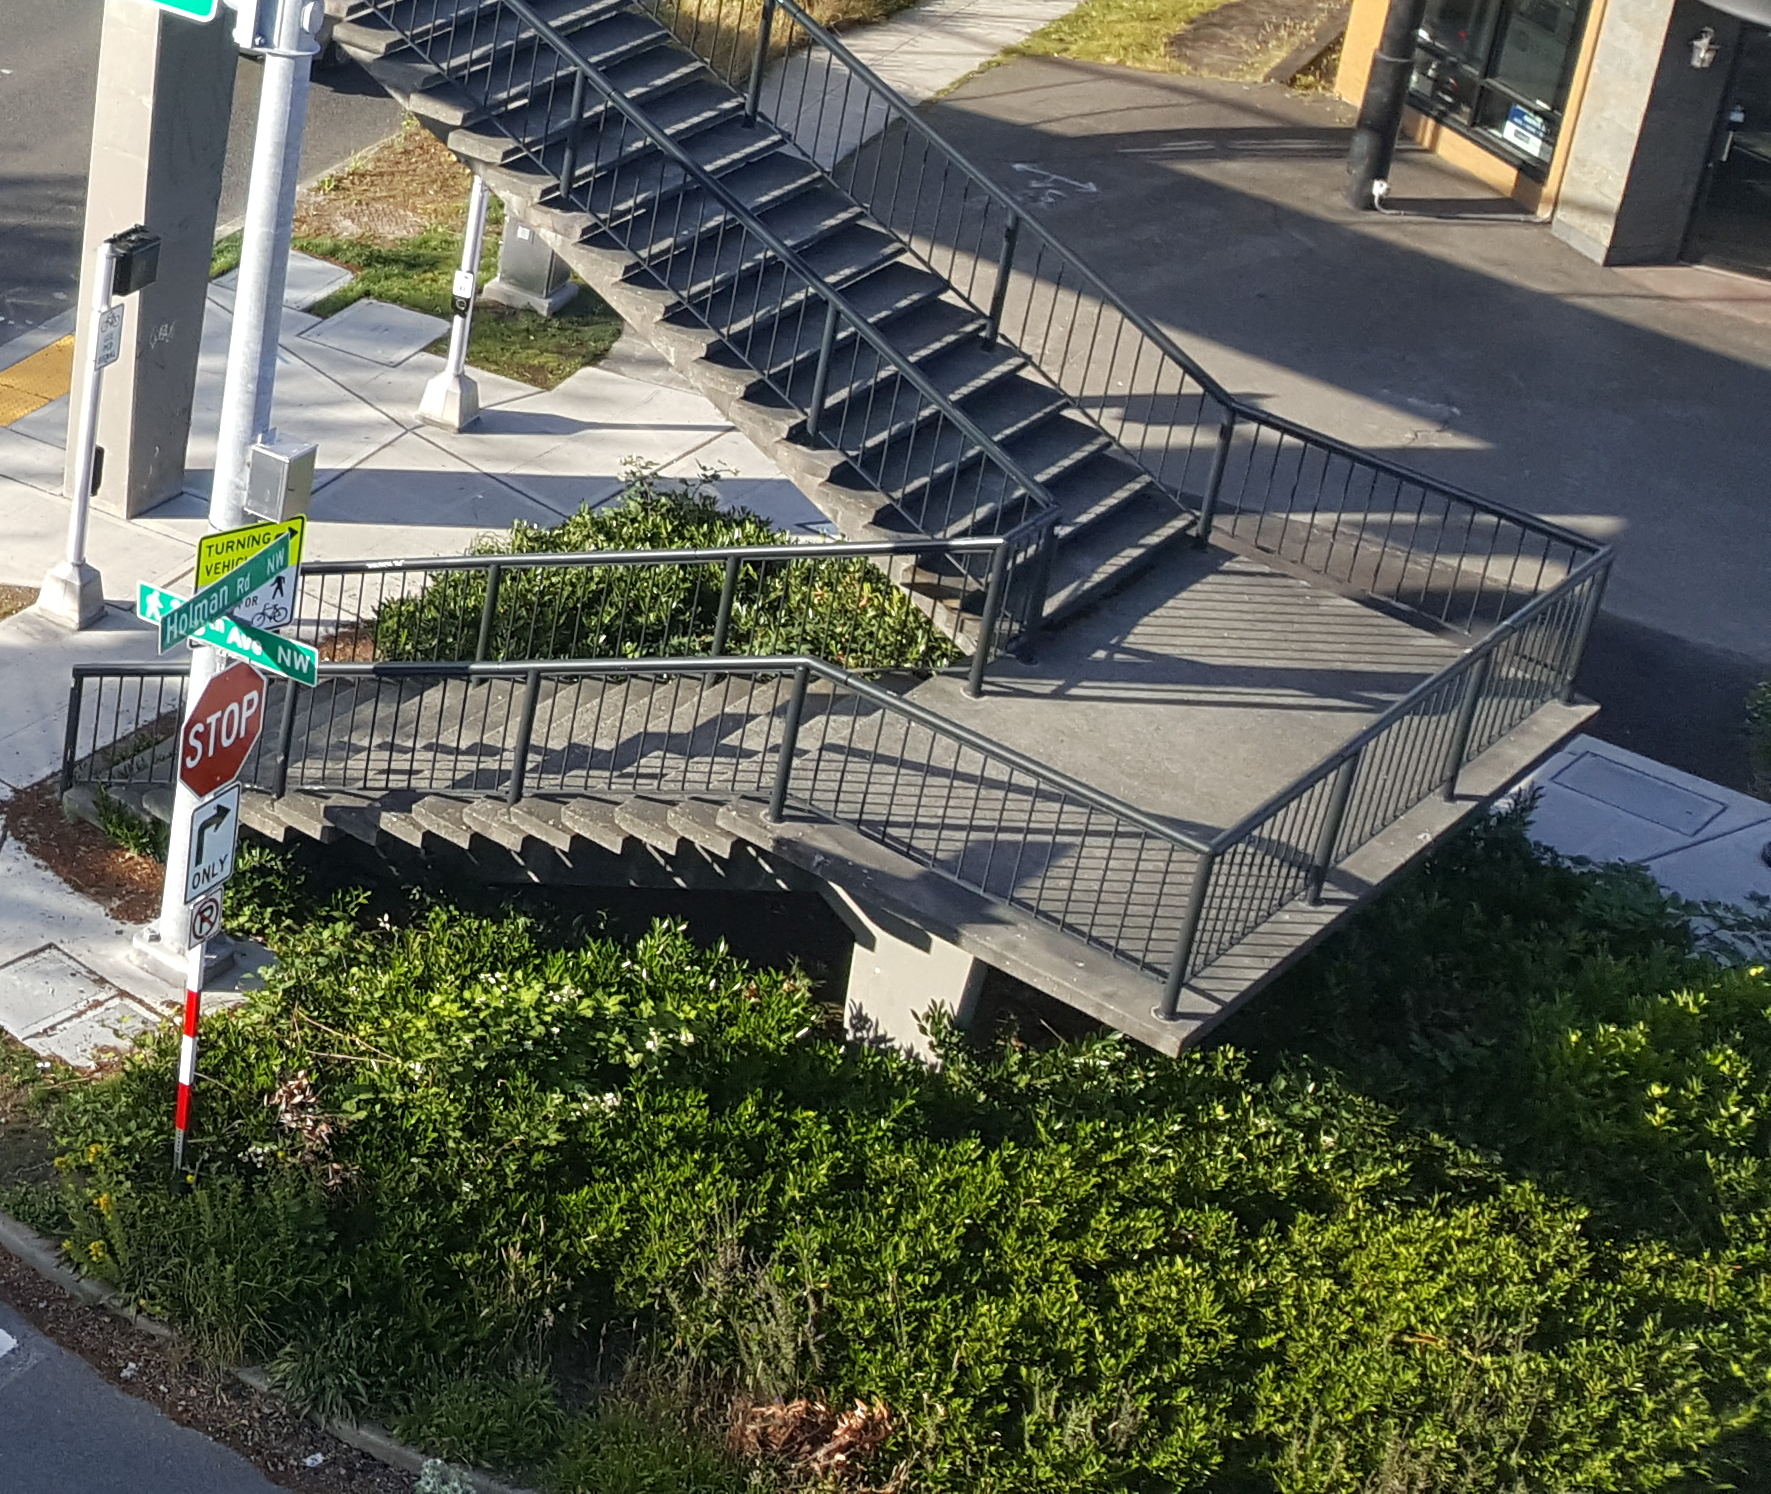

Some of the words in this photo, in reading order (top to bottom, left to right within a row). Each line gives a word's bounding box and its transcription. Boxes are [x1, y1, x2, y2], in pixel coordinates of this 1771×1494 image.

[205, 532, 272, 558] TURNING
[165, 585, 229, 644] Holman
[236, 572, 252, 597] Rd
[266, 547, 286, 575] NW
[226, 626, 263, 656] Ave
[277, 644, 311, 674] NW
[185, 689, 260, 769] STOP
[192, 853, 229, 891] ONLY
